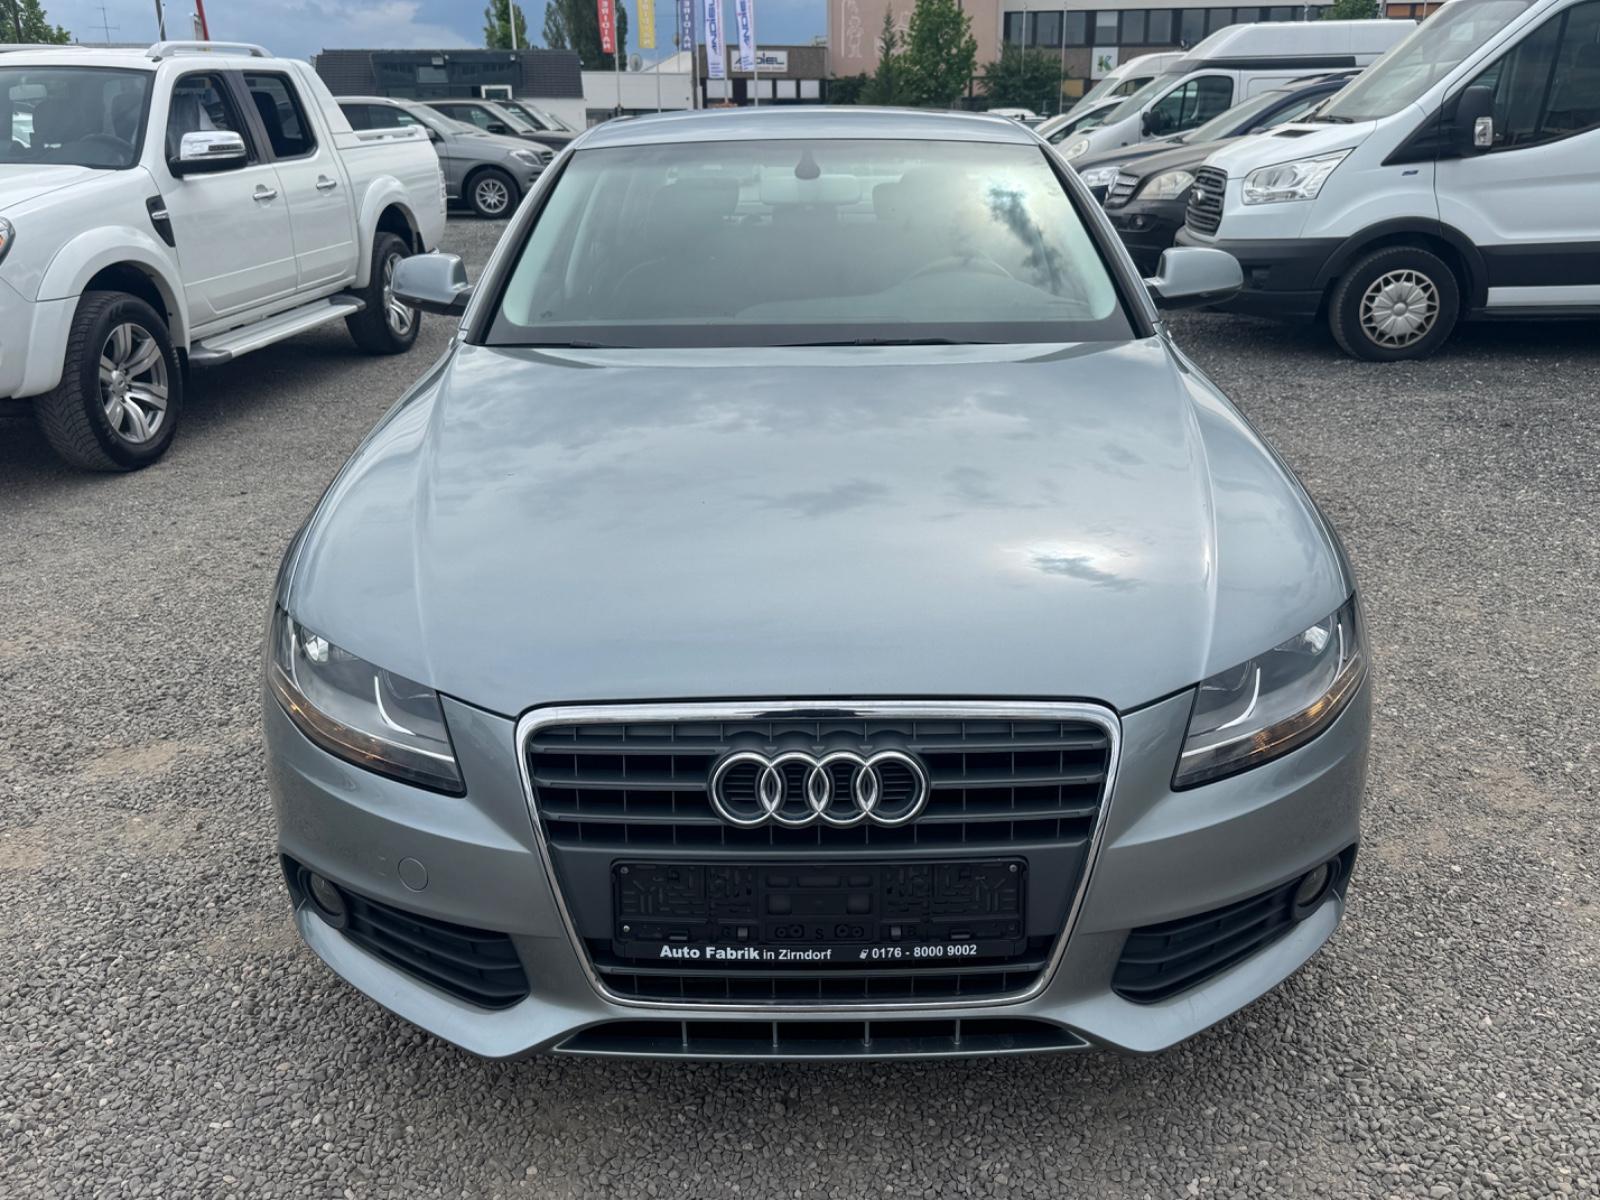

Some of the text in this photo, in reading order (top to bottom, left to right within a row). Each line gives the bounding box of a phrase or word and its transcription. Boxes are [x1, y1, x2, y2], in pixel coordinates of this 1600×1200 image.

[660, 945, 832, 960] Auto Fabrik in Zirndorf
[872, 947, 902, 959] 0176
[913, 946, 943, 958] 8000
[947, 944, 977, 956] 9002
